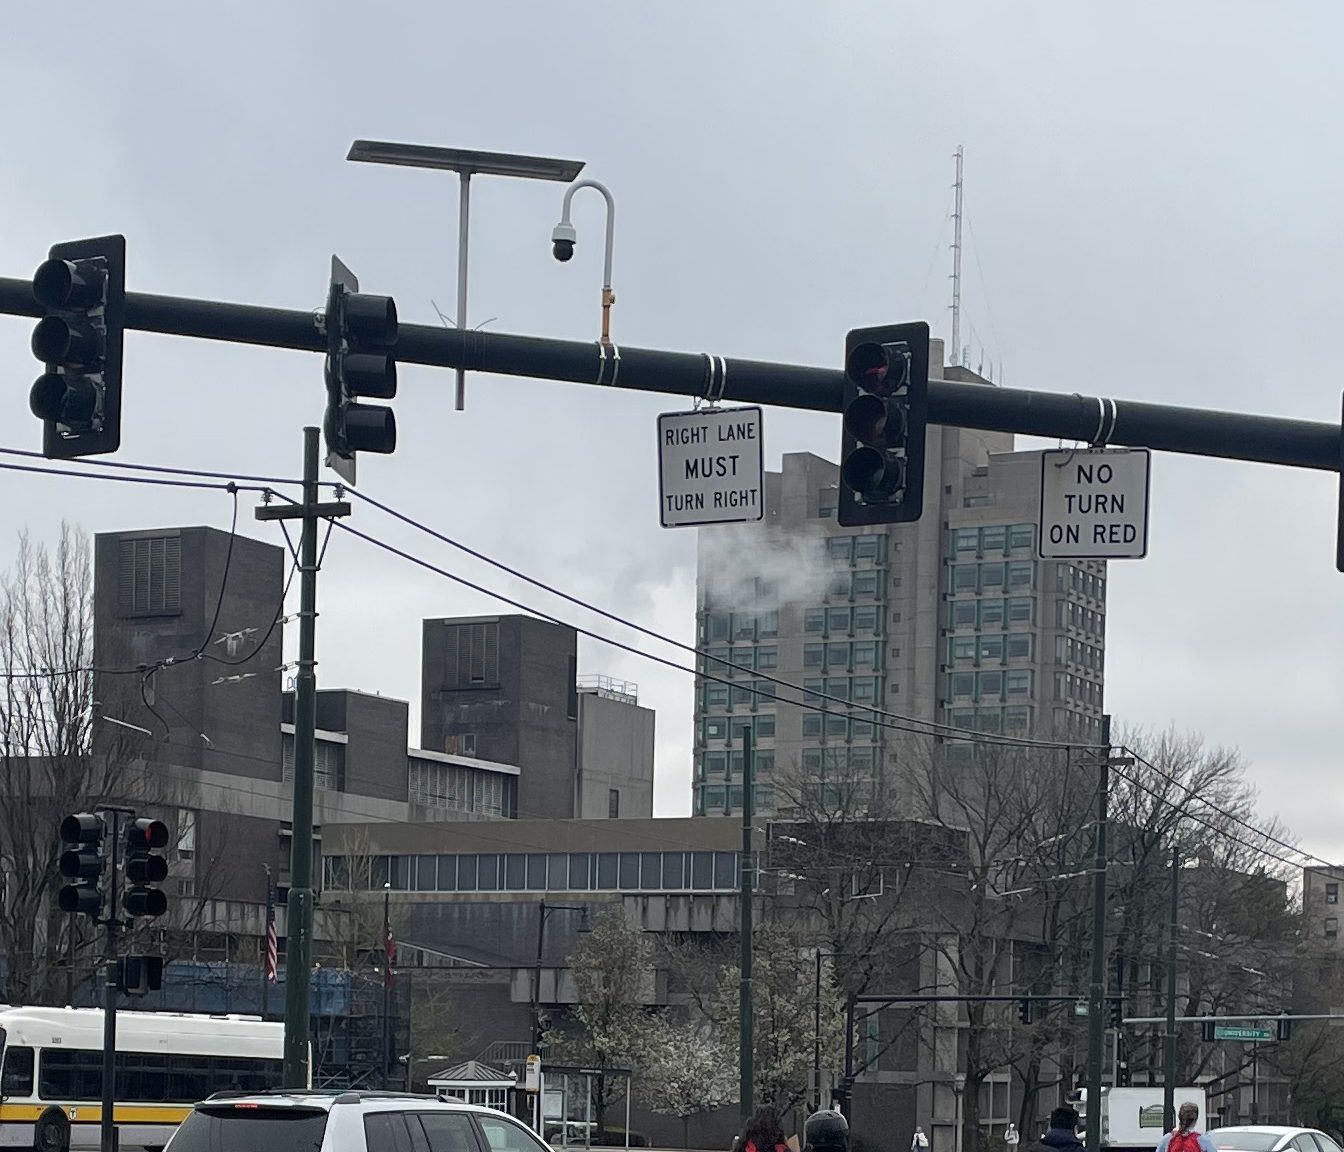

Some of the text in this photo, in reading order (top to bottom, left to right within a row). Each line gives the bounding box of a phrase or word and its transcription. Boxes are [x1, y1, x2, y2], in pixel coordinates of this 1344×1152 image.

[665, 422, 756, 446] RIGHT LANE
[685, 454, 740, 480] MUST
[1077, 464, 1113, 484] NO
[665, 489, 757, 512] TURN RIGHT
[1064, 494, 1125, 514] TURN
[1049, 524, 1137, 544] ON RED
[1223, 1029, 1261, 1037] UNIVERSITY
